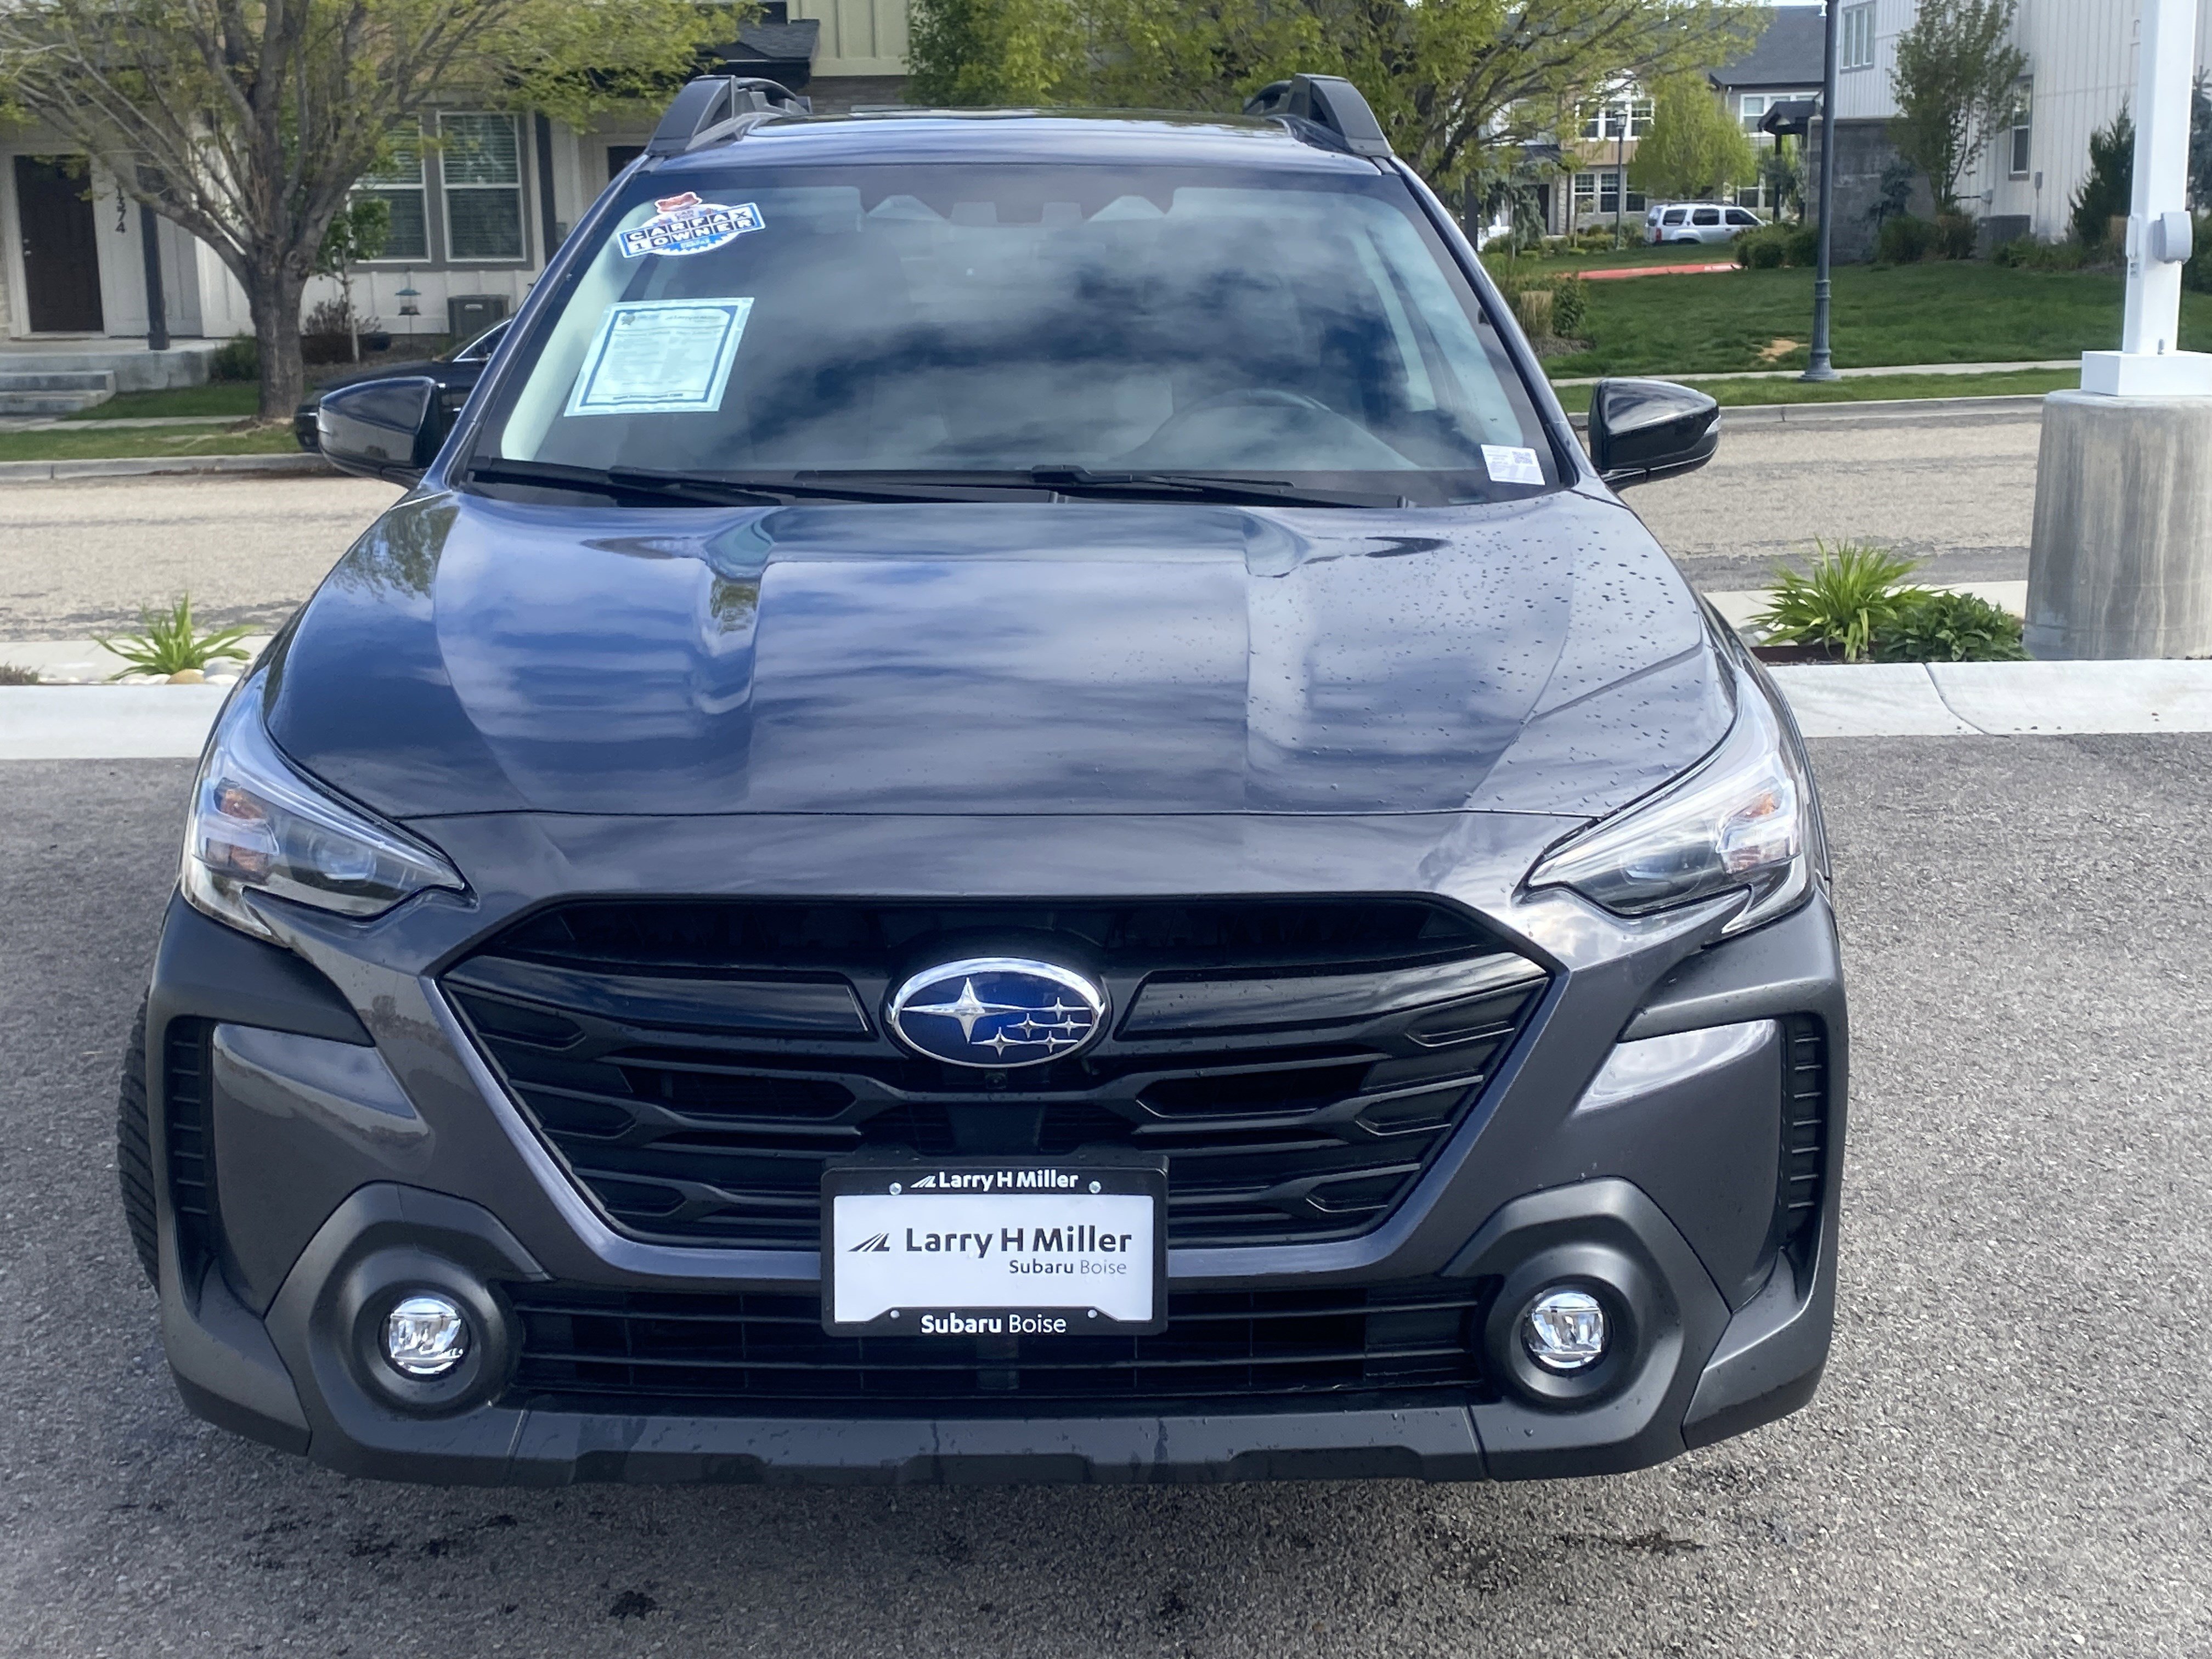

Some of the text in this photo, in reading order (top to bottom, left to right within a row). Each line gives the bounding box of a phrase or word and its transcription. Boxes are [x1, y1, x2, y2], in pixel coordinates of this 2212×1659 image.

[628, 210, 747, 240] CARFAX
[654, 218, 752, 246] OWNER
[939, 1169, 1079, 1192] Larry H Miller
[906, 1224, 1132, 1259] Larry H Miller
[1009, 1259, 1127, 1274] Subaru Boise
[921, 1312, 1066, 1333] Subaru Boise
